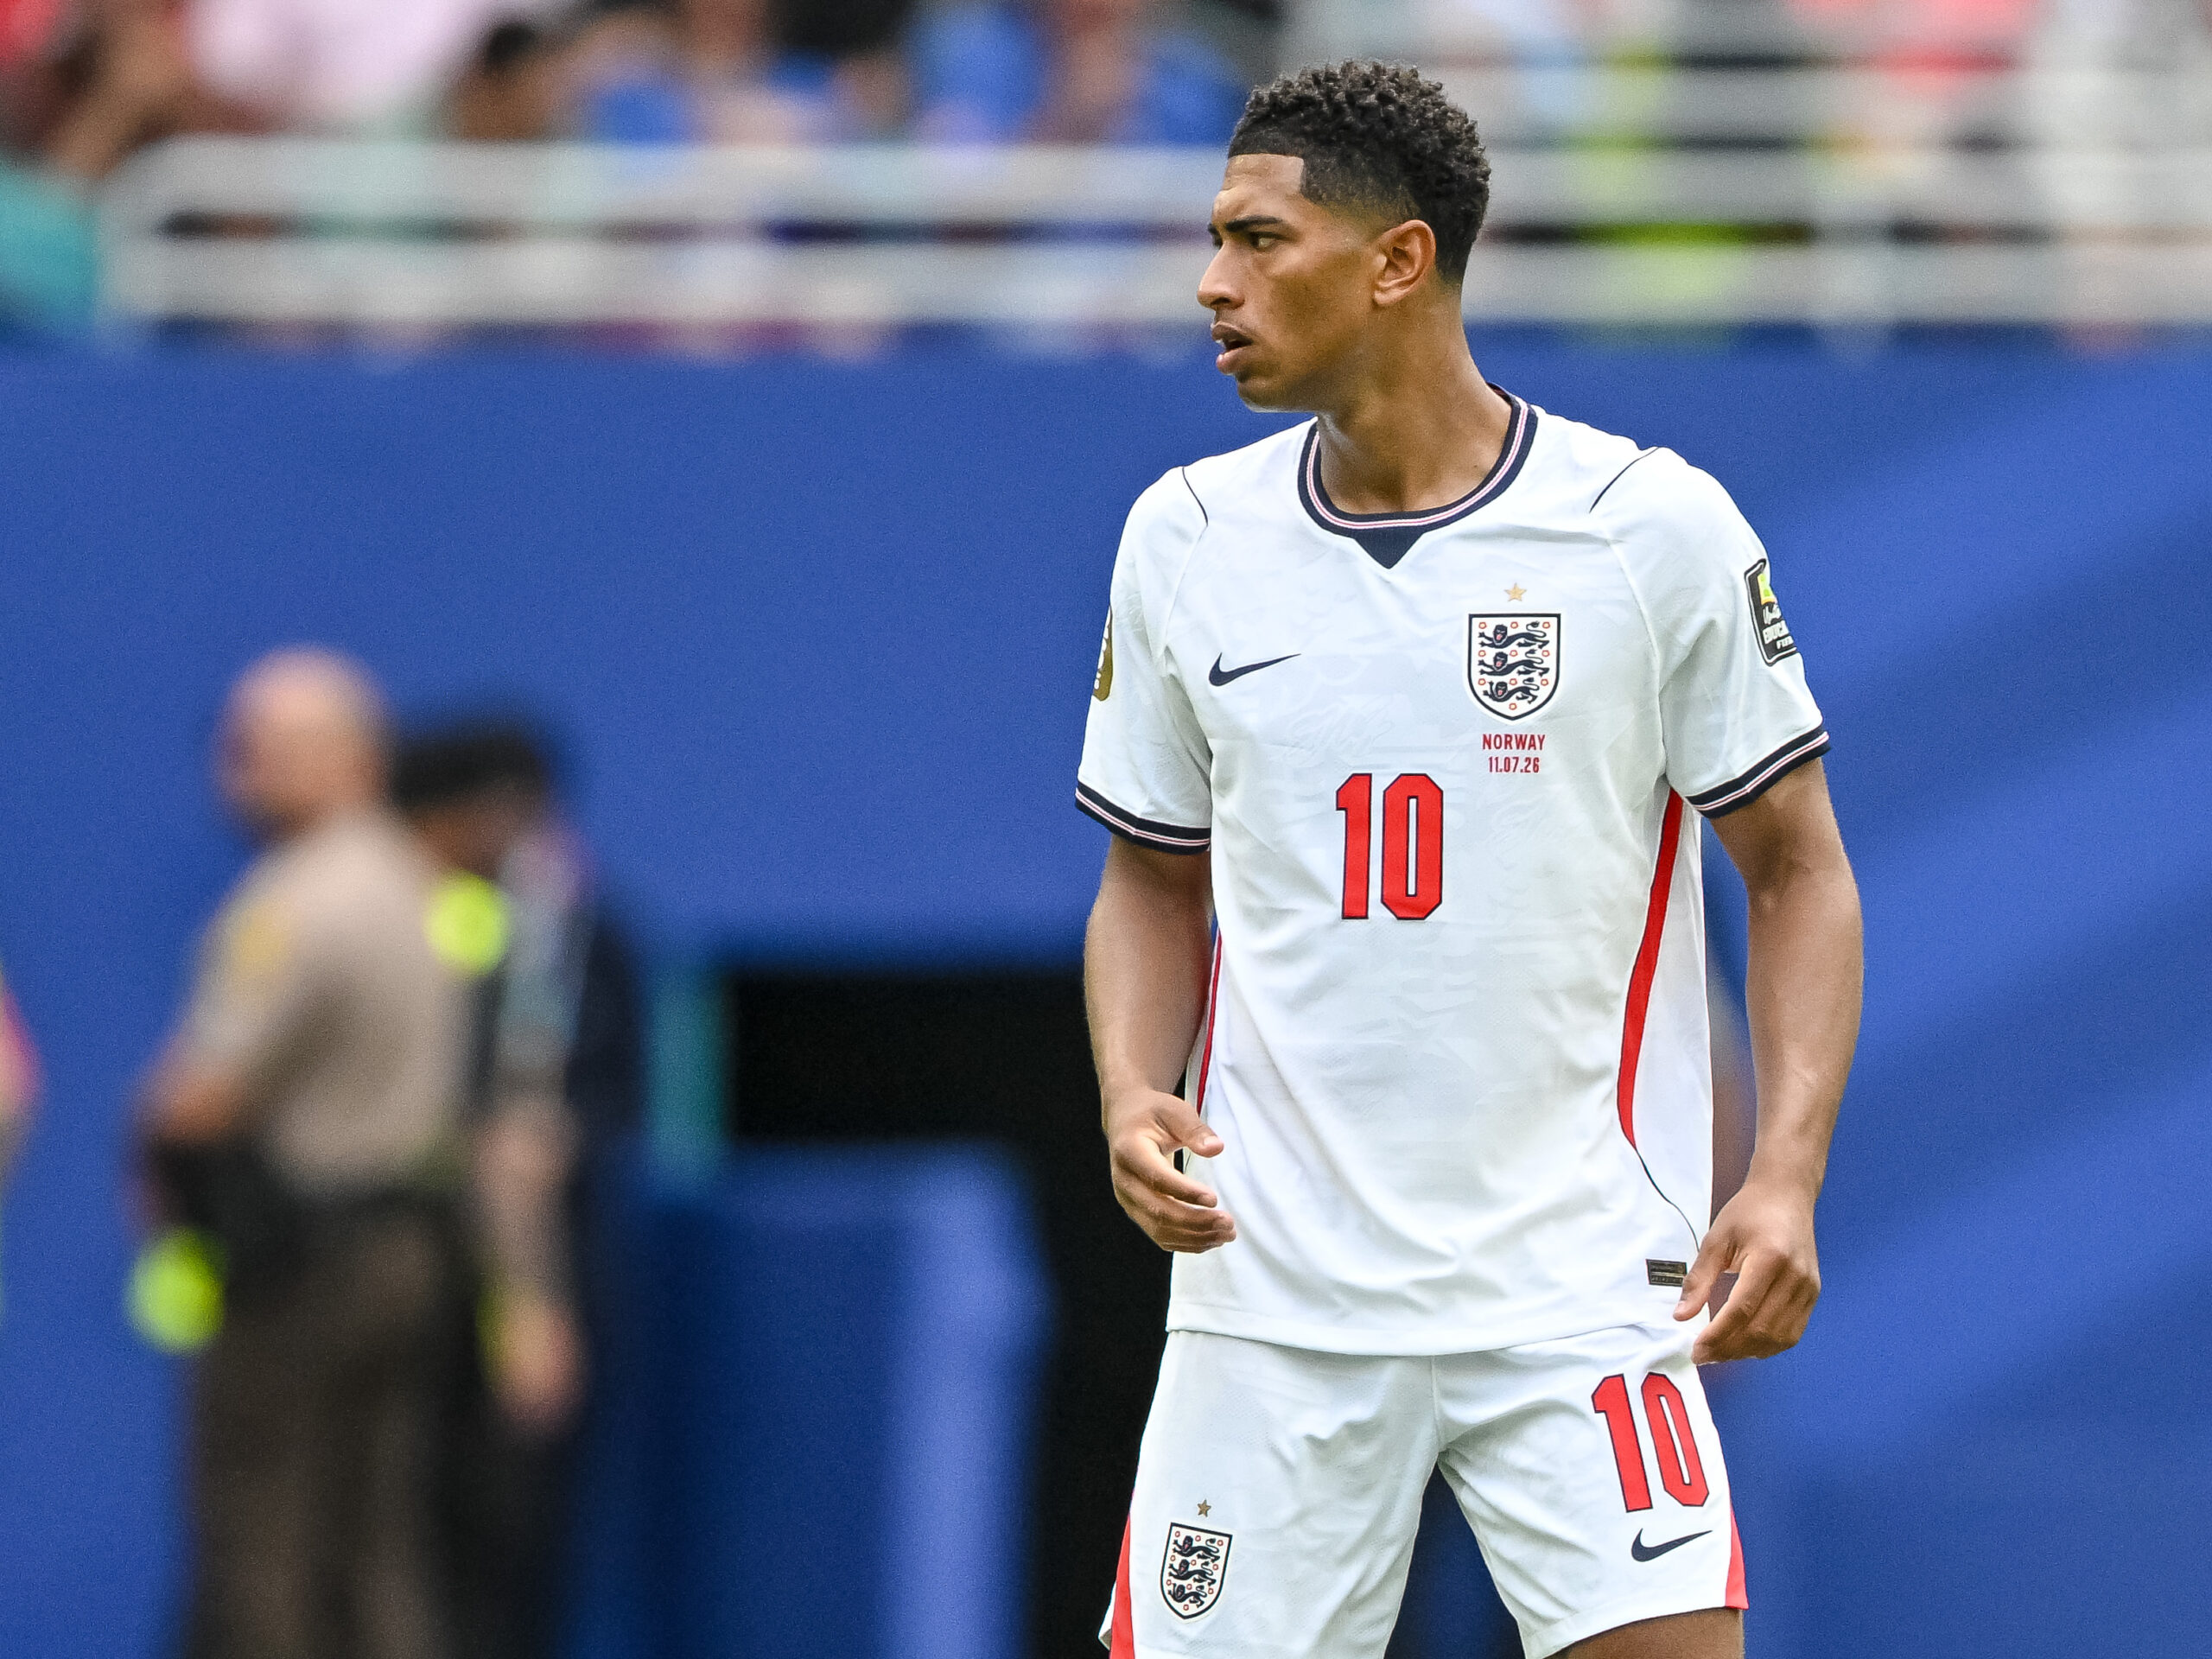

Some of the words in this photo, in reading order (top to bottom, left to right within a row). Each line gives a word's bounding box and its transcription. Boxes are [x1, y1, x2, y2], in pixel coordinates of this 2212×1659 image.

[1482, 734, 1545, 750] NORWAY
[1489, 756, 1540, 773] 11.07.26
[1336, 772, 1444, 920] 10
[1591, 1371, 1710, 1513] 10
